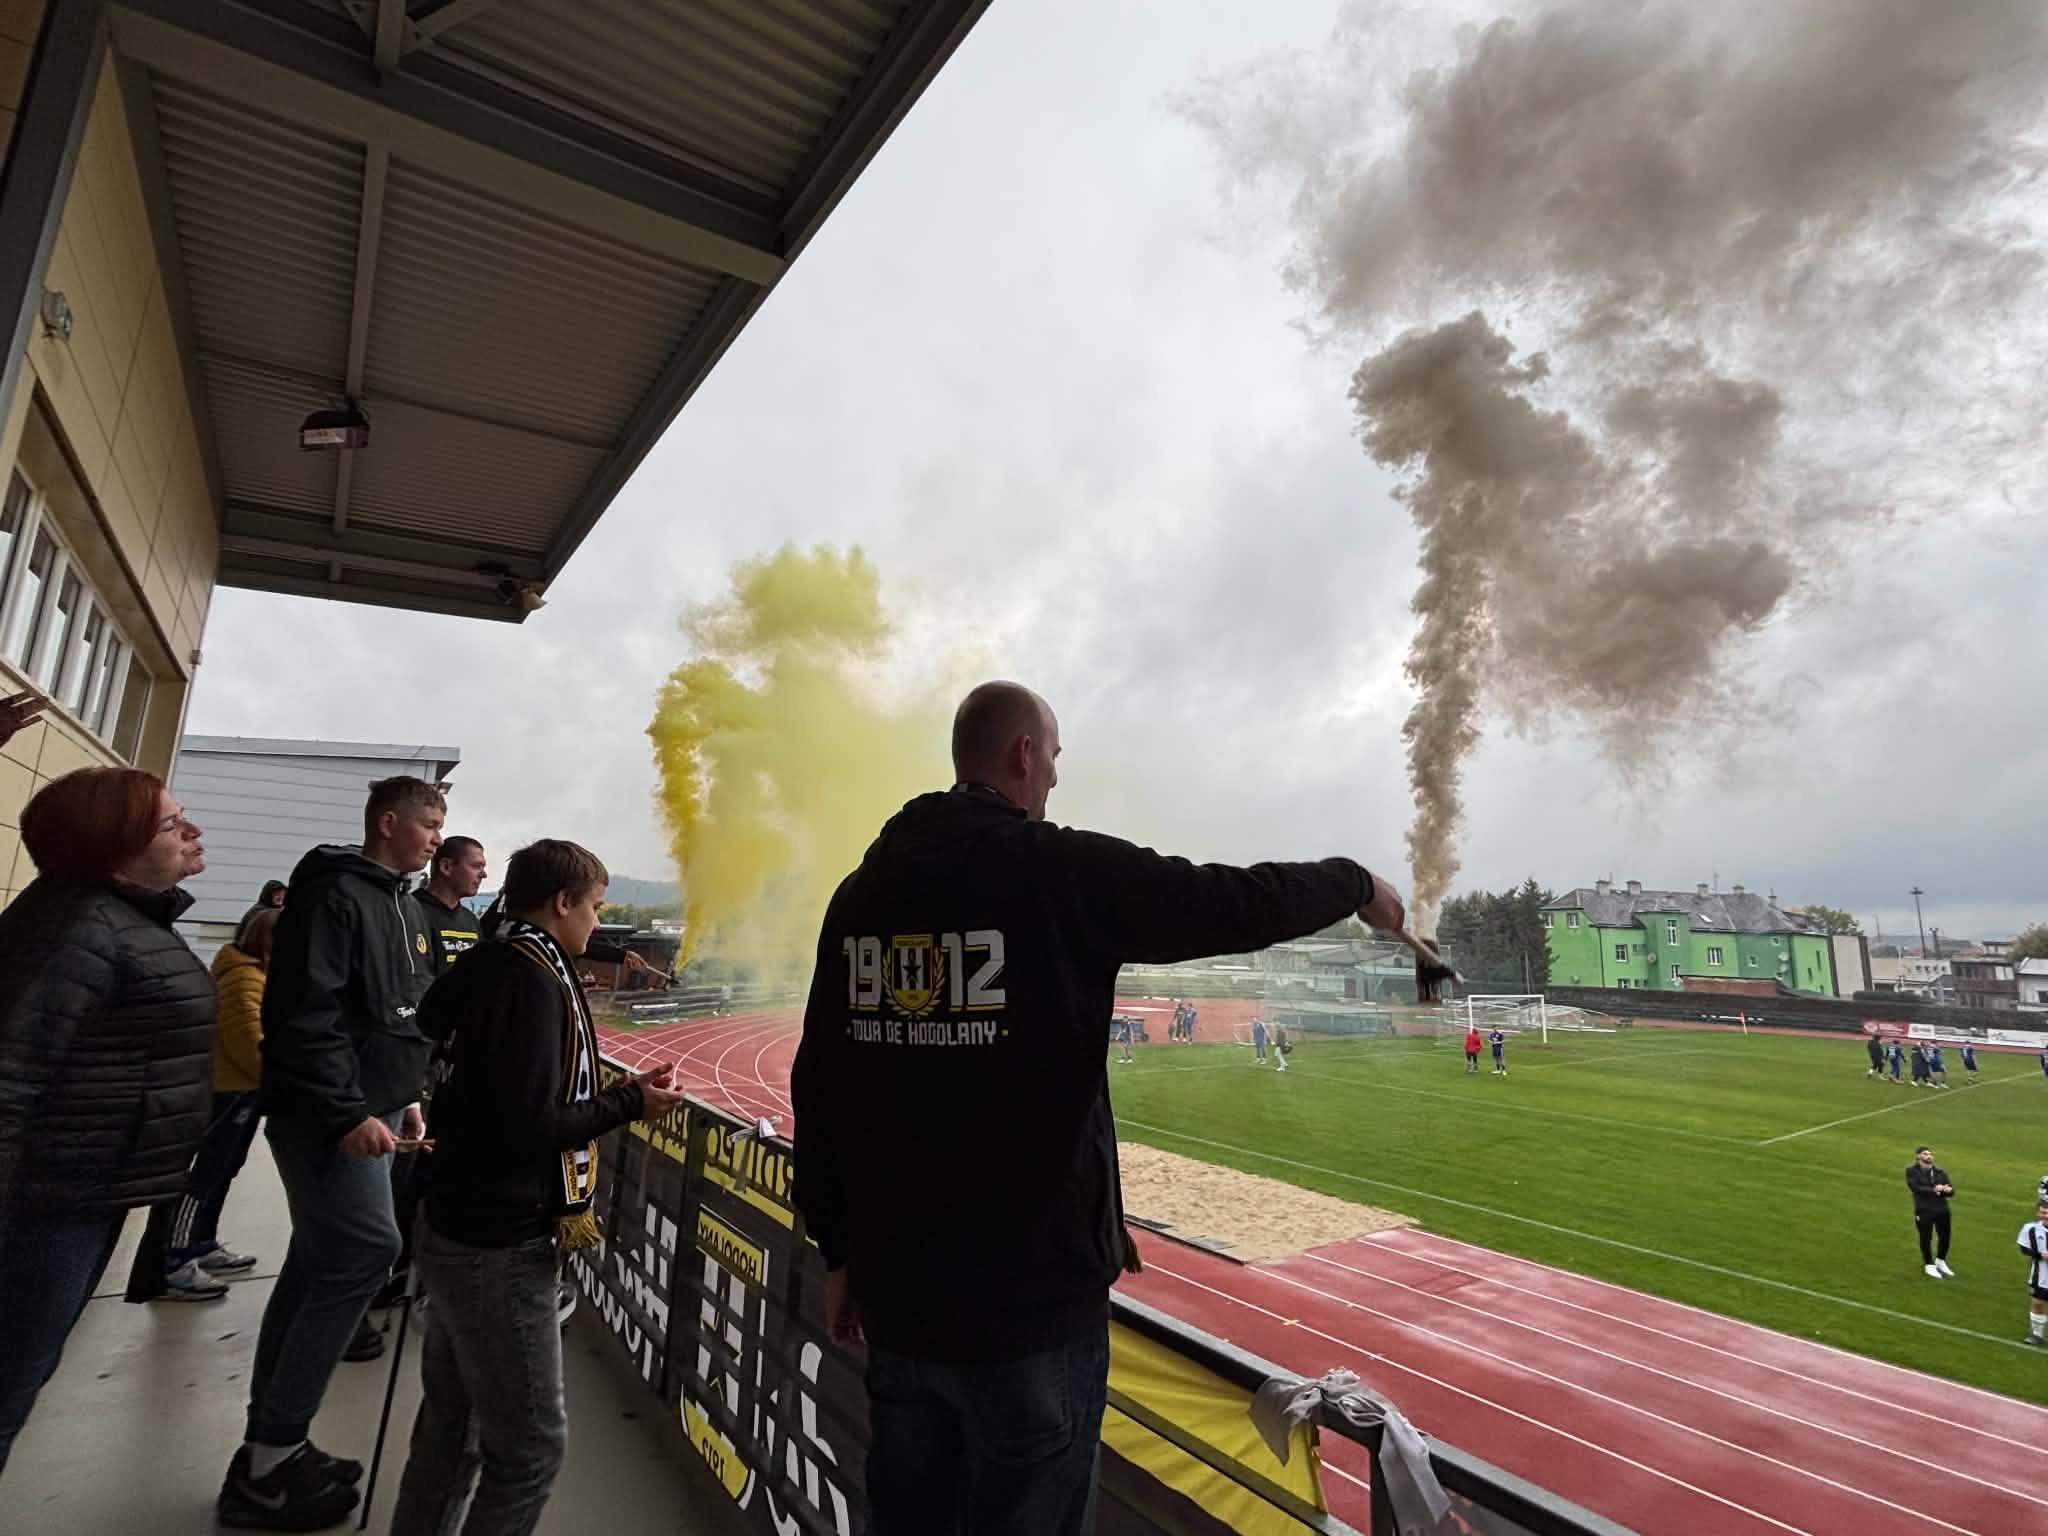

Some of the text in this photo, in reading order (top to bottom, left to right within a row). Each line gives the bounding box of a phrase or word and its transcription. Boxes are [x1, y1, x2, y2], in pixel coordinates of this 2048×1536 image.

[852, 1019, 997, 1046] TOUR DE HODOLANY
